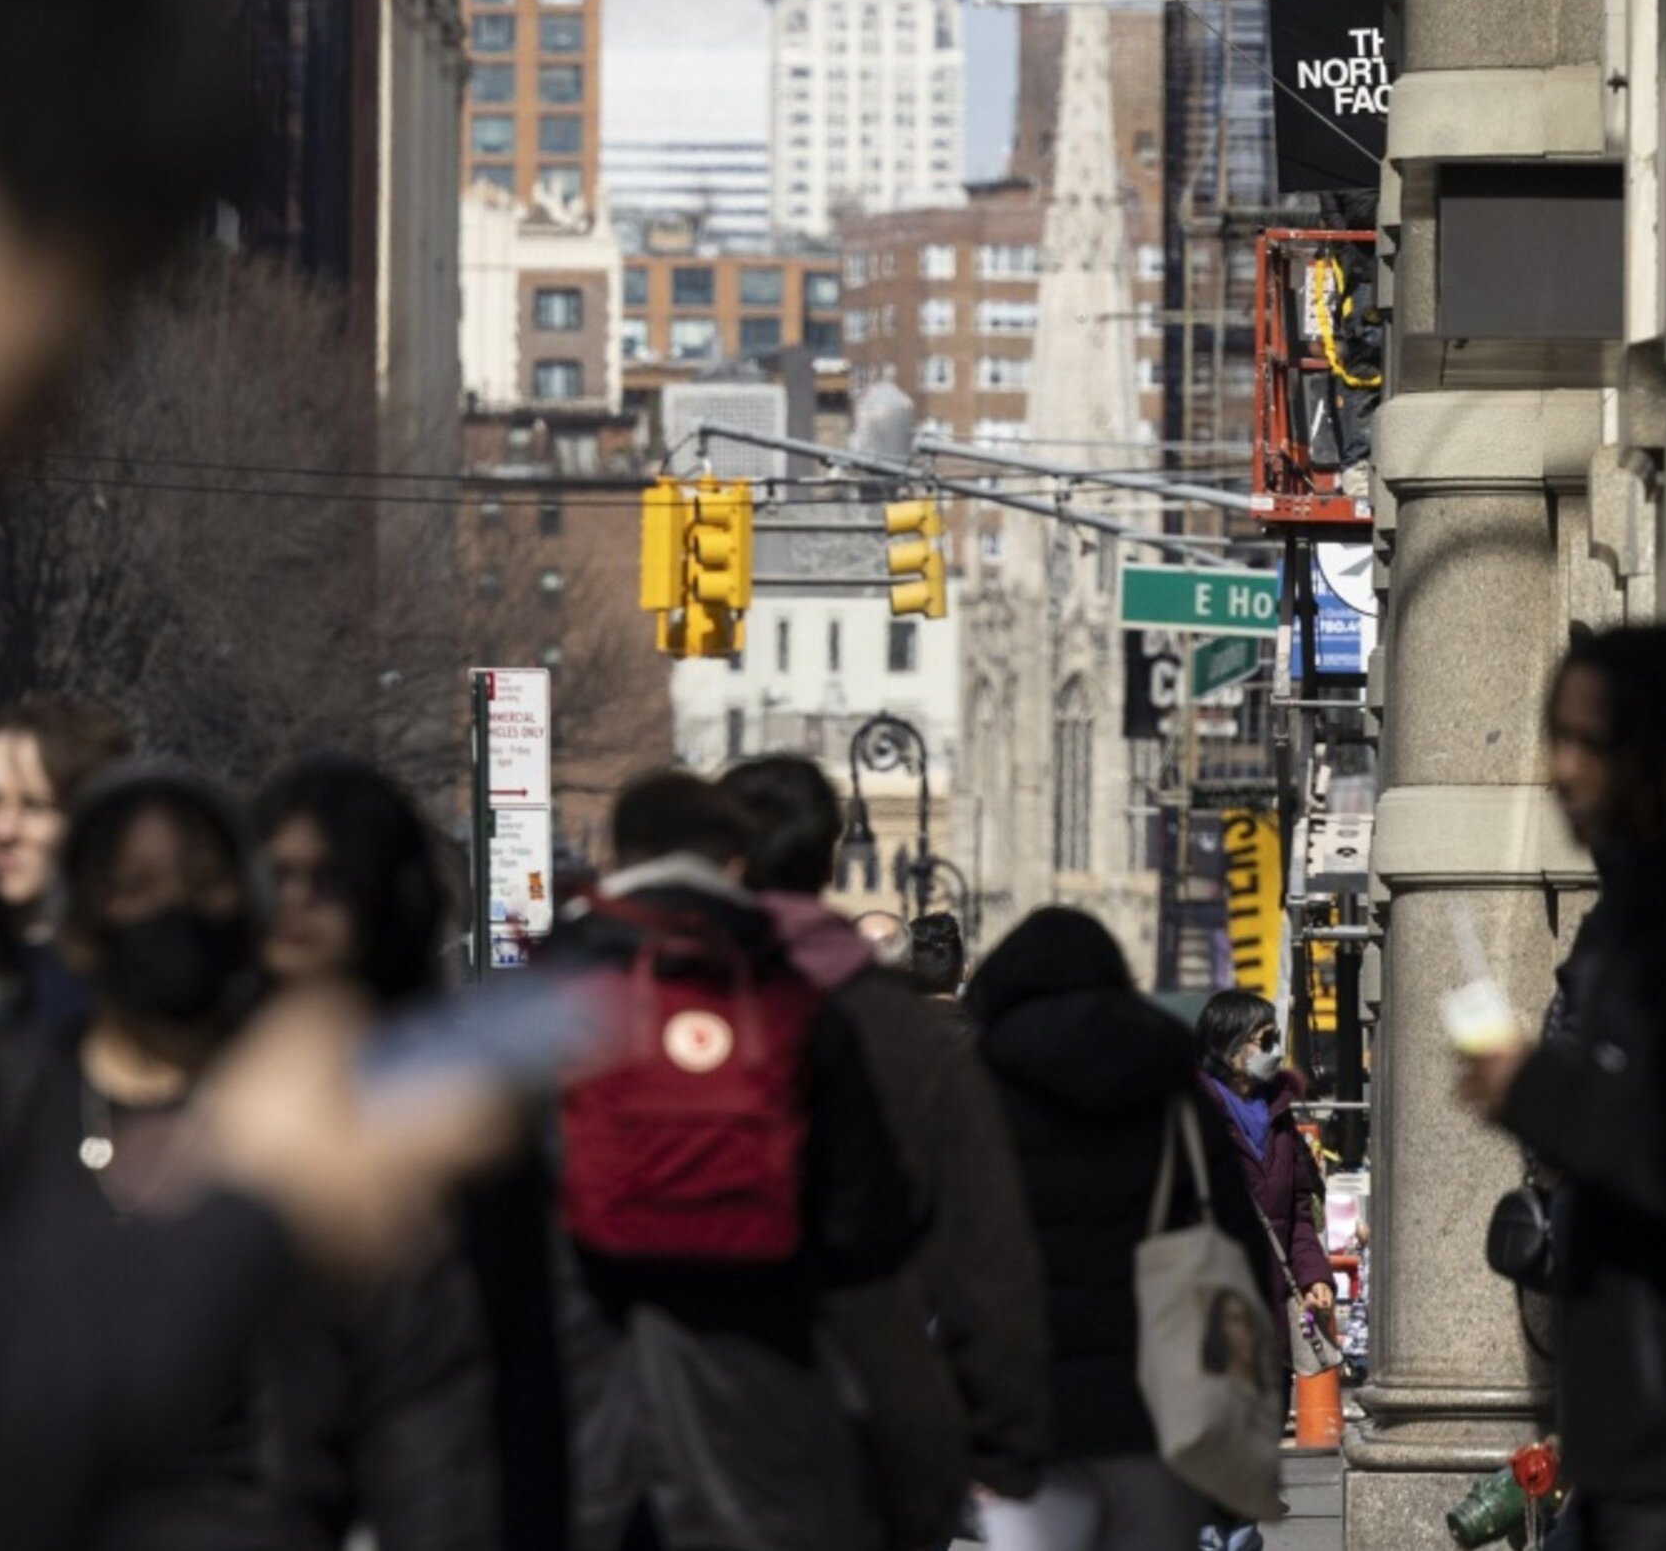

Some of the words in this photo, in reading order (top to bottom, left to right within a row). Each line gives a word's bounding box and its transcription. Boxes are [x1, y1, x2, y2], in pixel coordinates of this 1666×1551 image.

[1334, 84, 1393, 117] FAC
[1194, 582, 1213, 617] E
[1228, 584, 1273, 619] Ho
